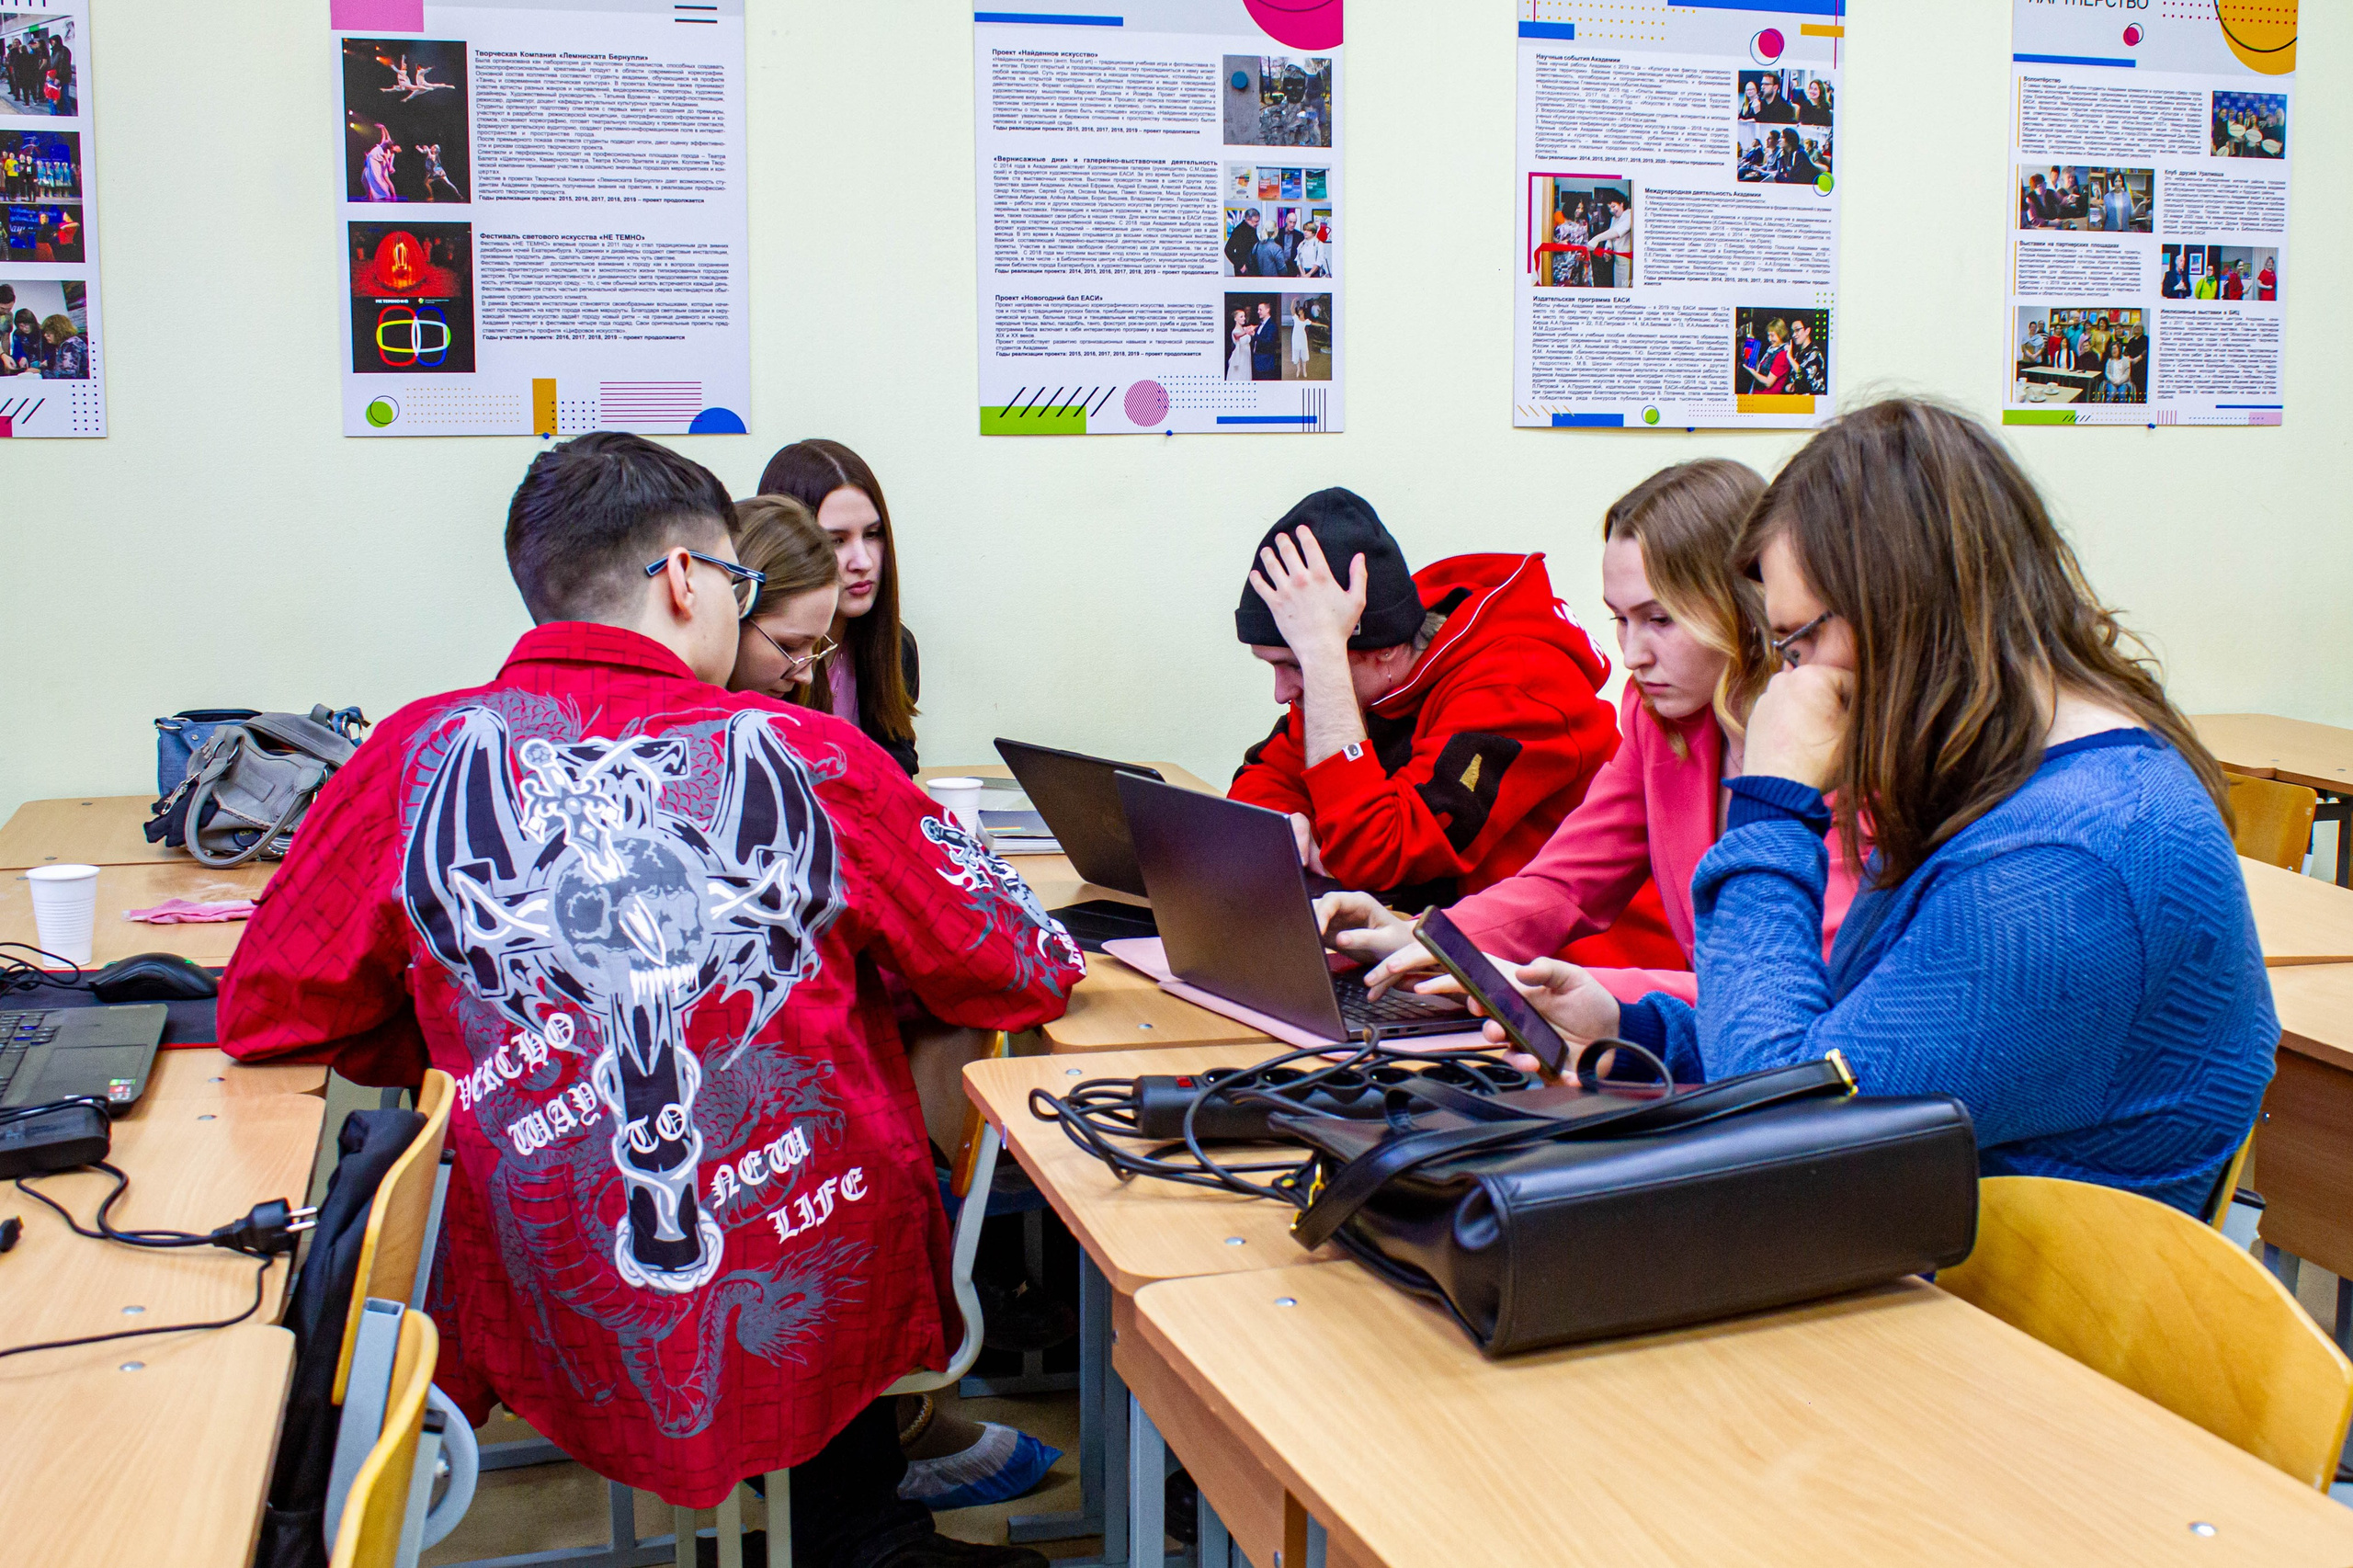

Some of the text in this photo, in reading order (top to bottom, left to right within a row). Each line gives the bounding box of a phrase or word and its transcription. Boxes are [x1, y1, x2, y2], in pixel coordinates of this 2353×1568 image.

[558, 51, 607, 60] «Лемниската
[608, 53, 648, 62] Бернулли»
[991, 48, 1016, 56] Проект
[1017, 49, 1059, 57] «Найденное
[507, 1081, 811, 1210] WAY TO NEW
[766, 1166, 869, 1244] LIFE
